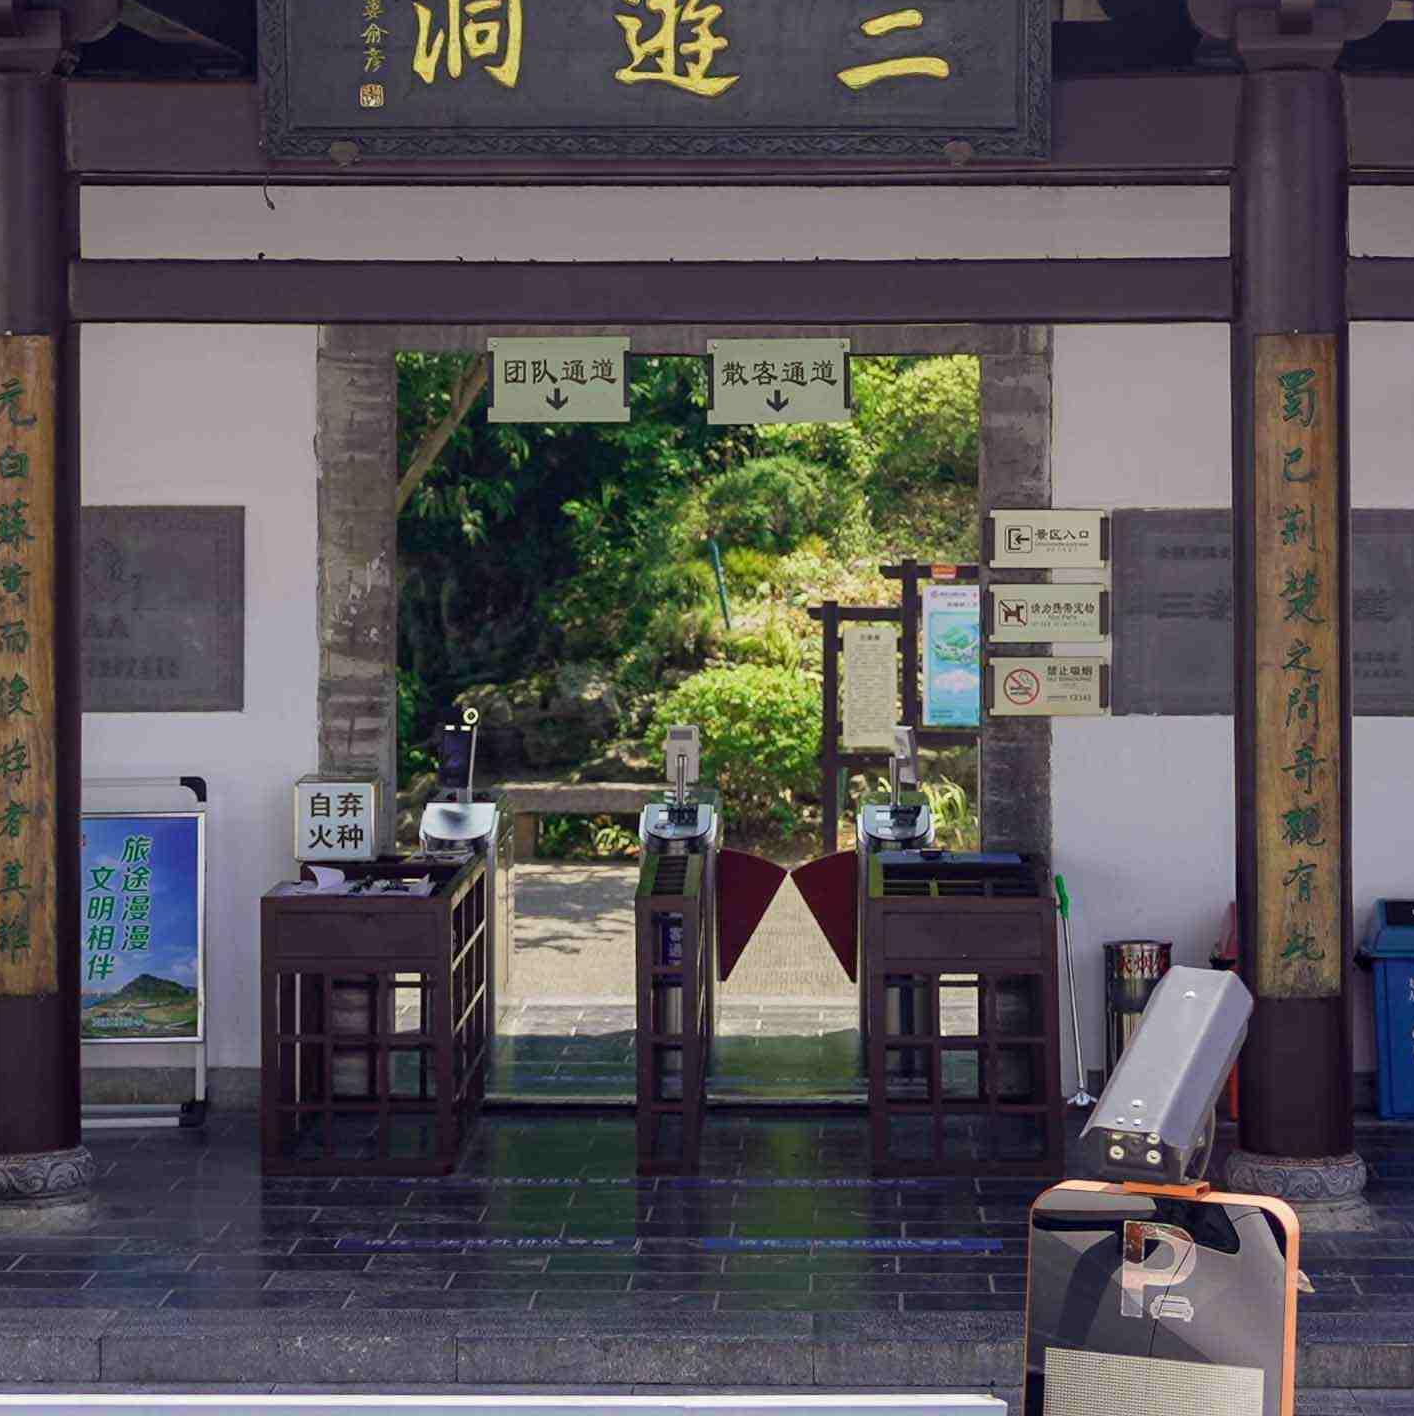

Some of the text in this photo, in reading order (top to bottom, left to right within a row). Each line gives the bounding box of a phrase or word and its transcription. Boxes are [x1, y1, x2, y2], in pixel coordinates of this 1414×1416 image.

[503, 358, 618, 385] 团队通道
[721, 359, 838, 386] 散客通道
[1035, 528, 1089, 541] 景区入口
[1047, 665, 1093, 676] 禁止吸烟
[309, 792, 364, 819] 自弃
[308, 823, 364, 850] 火种
[120, 834, 154, 953] 旅途漫漫
[85, 865, 117, 982] 文明相伴
[1121, 1220, 1197, 1317] P
